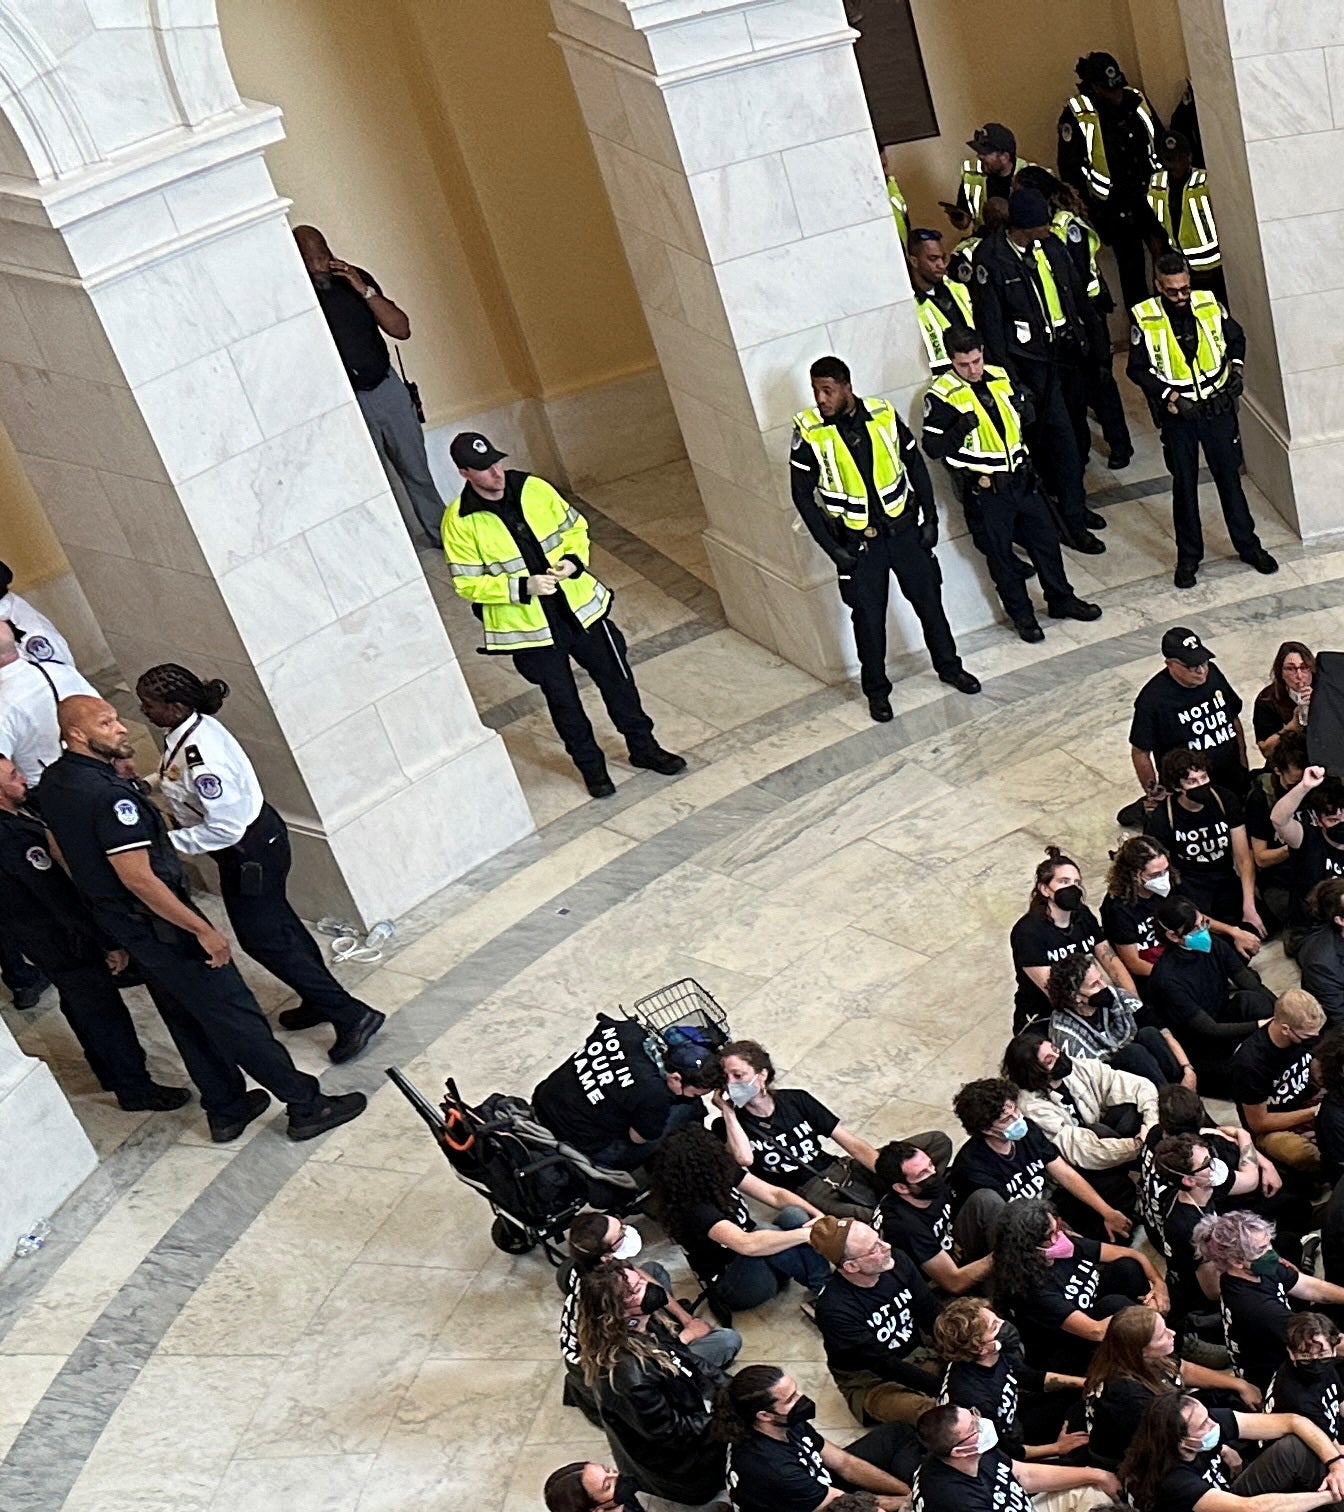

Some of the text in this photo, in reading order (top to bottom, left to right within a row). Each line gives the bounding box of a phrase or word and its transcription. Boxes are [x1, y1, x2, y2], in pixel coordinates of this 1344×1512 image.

[1178, 701, 1211, 725] NOT
[1191, 711, 1228, 735] OUR
[1176, 825, 1208, 843] NOT
[1046, 945, 1074, 962] NOT
[587, 1042, 615, 1086] OUR
[601, 1027, 634, 1088] NOT IN
[793, 1120, 812, 1139] IN
